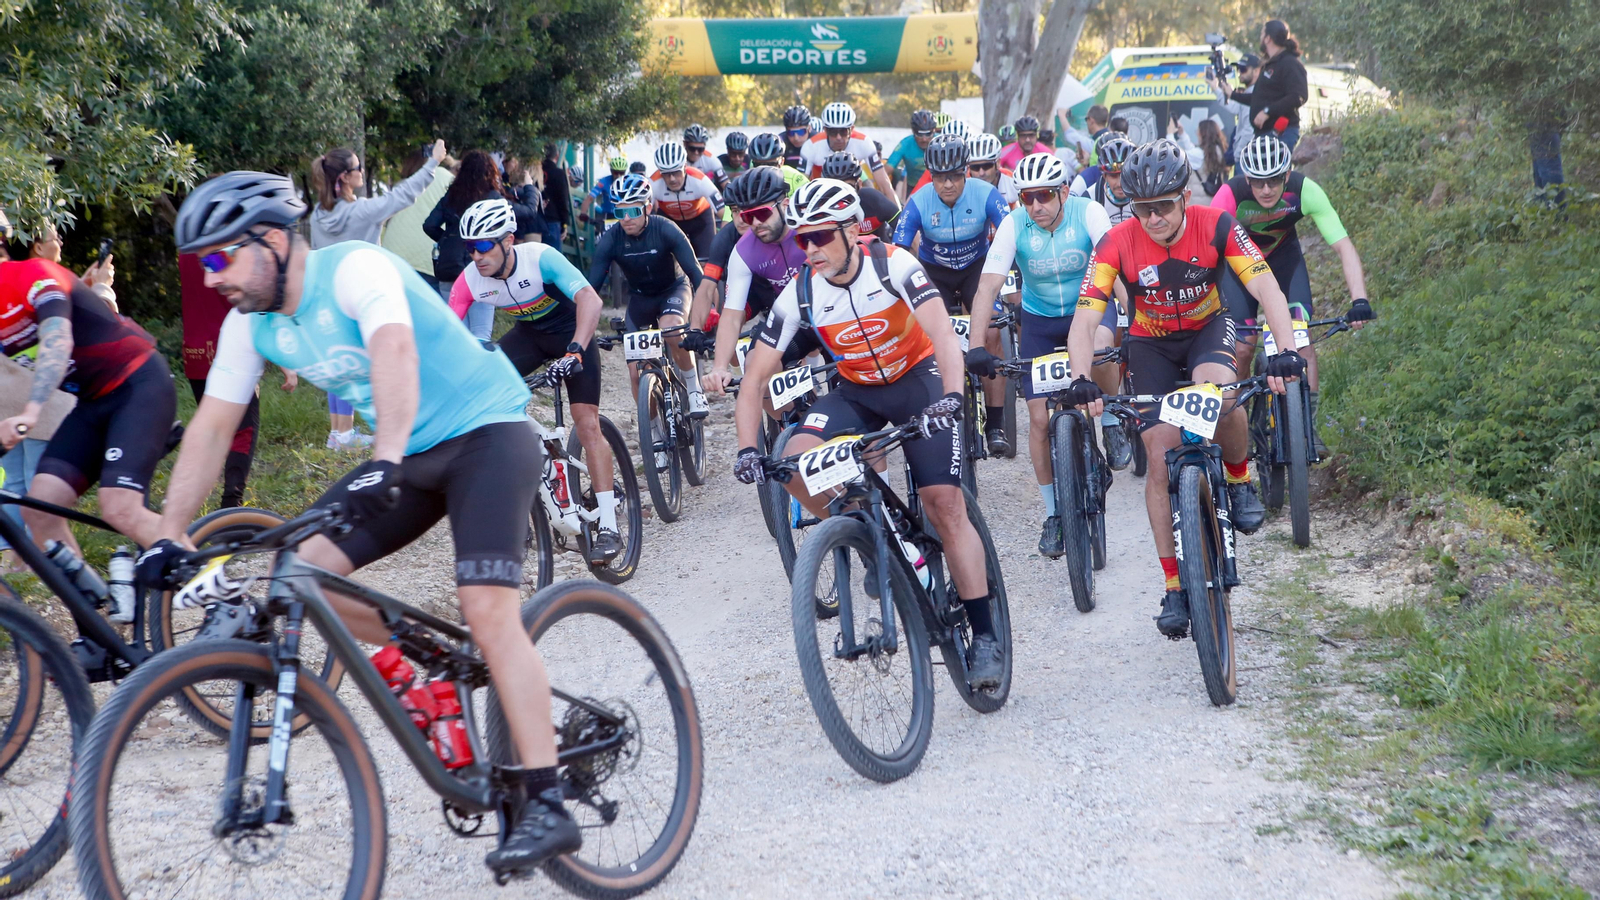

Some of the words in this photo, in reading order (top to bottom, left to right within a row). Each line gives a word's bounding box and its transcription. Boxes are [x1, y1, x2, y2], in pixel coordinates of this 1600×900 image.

[740, 38, 793, 47] DELEGACIÓN
[740, 49, 867, 65] DEPORTES
[1121, 84, 1214, 98] AMBULANCI
[1233, 224, 1262, 261] FALIBIKE
[1028, 254, 1079, 270] ASSIDO
[1080, 250, 1097, 295] FALIBIKE
[841, 324, 882, 341] SYMISUR
[626, 333, 660, 350] 184
[772, 366, 810, 396] 062
[1167, 392, 1220, 422] 088
[804, 441, 855, 478] 228
